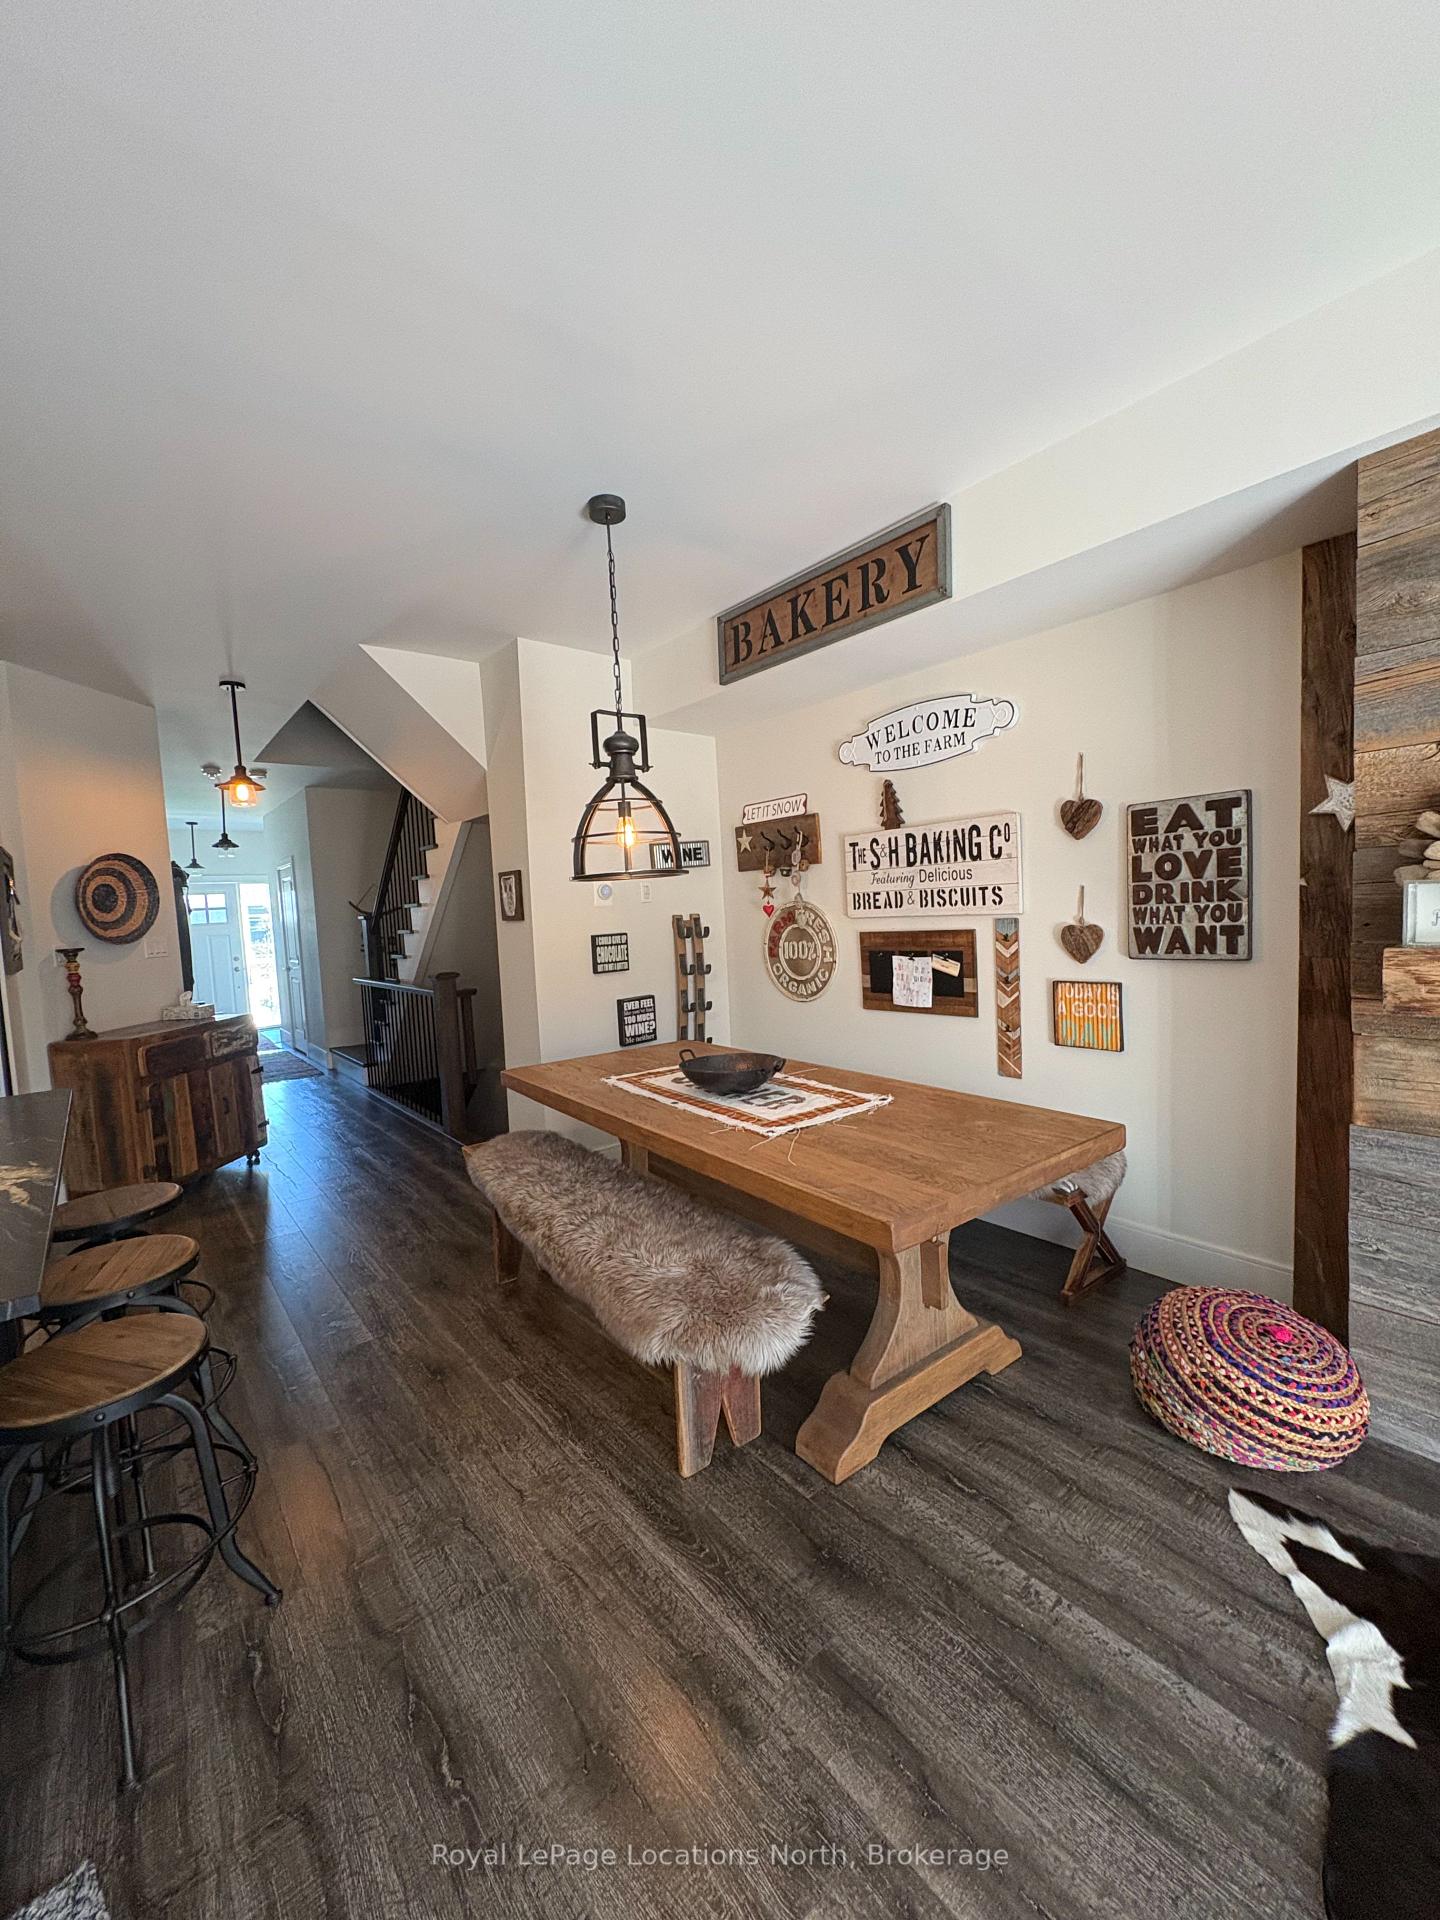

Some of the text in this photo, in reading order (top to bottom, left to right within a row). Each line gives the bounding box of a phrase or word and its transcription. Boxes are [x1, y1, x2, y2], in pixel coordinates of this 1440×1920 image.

[731, 534, 930, 666] BAKERY
[865, 707, 977, 751] WELCOME
[875, 731, 966, 765] TO THE FARM
[746, 798, 803, 821] LET IT SNOW
[1130, 796, 1242, 837] EAT
[905, 824, 982, 867] BAKING
[1131, 828, 1242, 854] WHAT YOU
[661, 847, 703, 863] WNE
[1131, 847, 1243, 883] LOVE
[871, 868, 973, 888] Featuring Delicious
[852, 885, 1004, 910] BREAD & BISCUITS
[1132, 878, 1248, 905] DRINK
[1132, 903, 1243, 925] WHAT YOU
[783, 940, 816, 961] 100%
[1132, 924, 1245, 955] WANT
[772, 962, 829, 996] ORGANIC
[623, 998, 653, 1011] EVER FEEL
[1072, 1001, 1119, 1020] GOOD
[624, 1012, 654, 1025] TOO MUCH
[625, 1020, 656, 1037] WINE?
[1061, 1018, 1115, 1051] DAY
